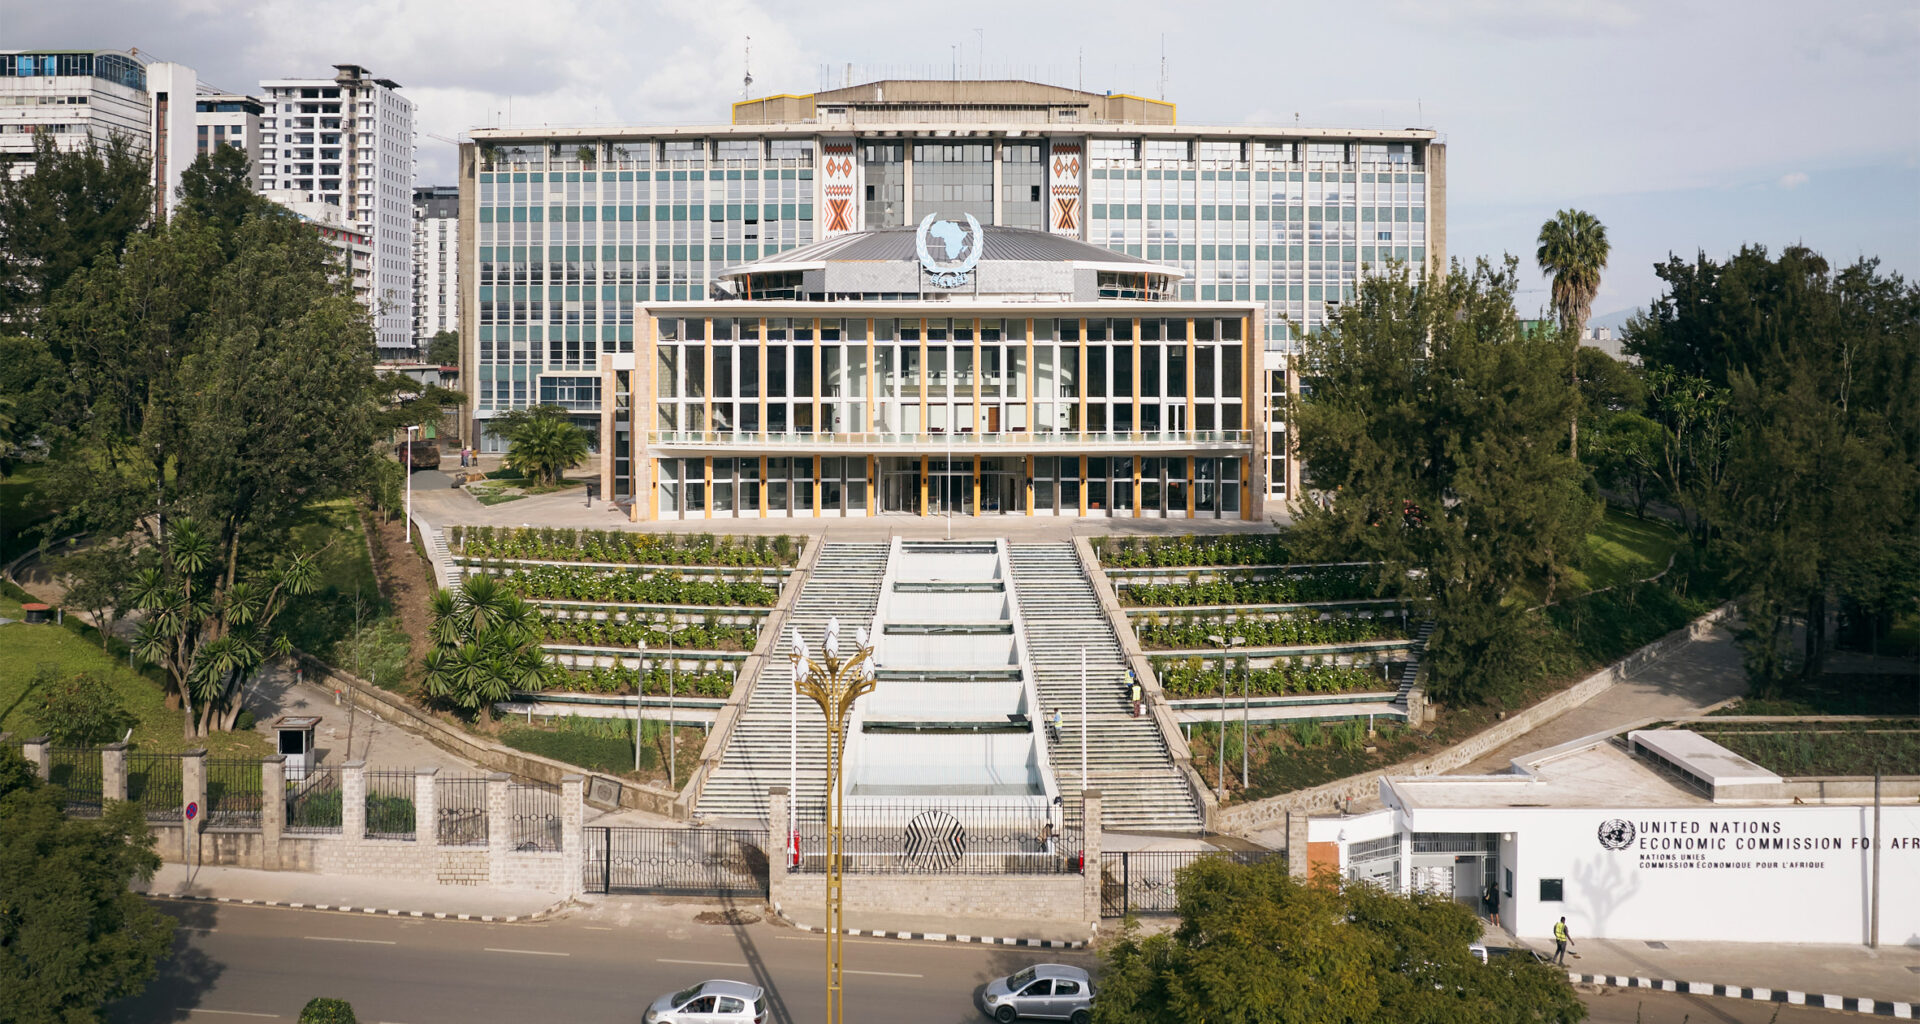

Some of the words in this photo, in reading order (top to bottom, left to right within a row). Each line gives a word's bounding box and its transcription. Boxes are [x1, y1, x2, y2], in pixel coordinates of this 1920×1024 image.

[1640, 821, 1700, 834] UNITED
[1709, 821, 1781, 834] NATIONS
[1639, 837, 1726, 850] ECONOMIC
[1735, 837, 1842, 850] COMMISSION
[1851, 837, 1880, 850] FO
[1639, 853, 1677, 861] NATIONS
[1680, 853, 1706, 861] UNIES
[1639, 861, 1694, 869] COMMISSION
[1696, 860, 1751, 869] ÉCONOMIQUE
[1755, 861, 1779, 869] POUR
[1782, 861, 1825, 869] L'AFRIQUE
